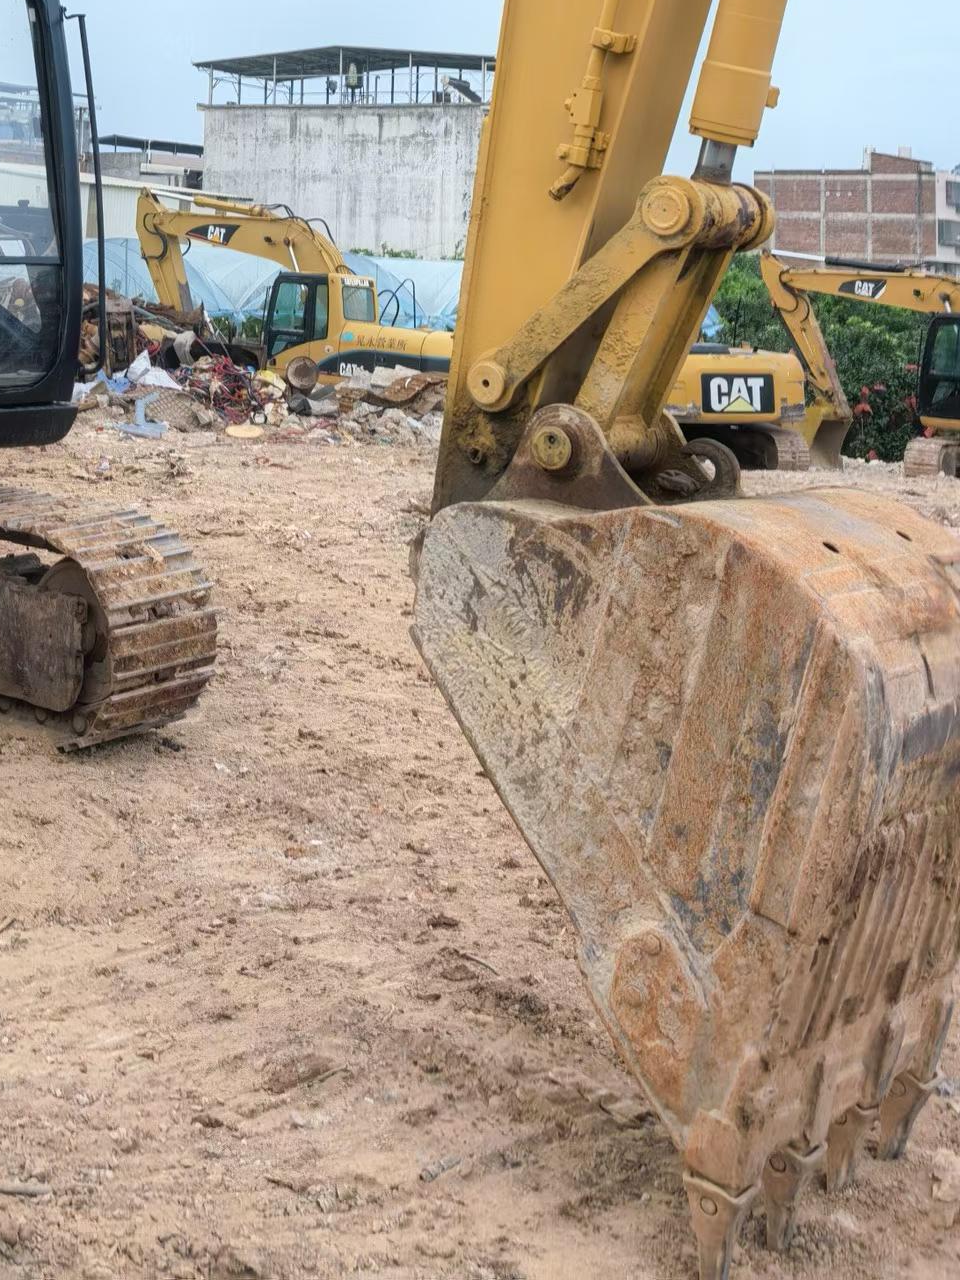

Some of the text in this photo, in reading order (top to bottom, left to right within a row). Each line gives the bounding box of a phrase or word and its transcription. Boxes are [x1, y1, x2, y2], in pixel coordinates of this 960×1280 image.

[207, 225, 226, 243] CAT
[854, 280, 875, 297] CAT
[709, 376, 765, 413] CAT
